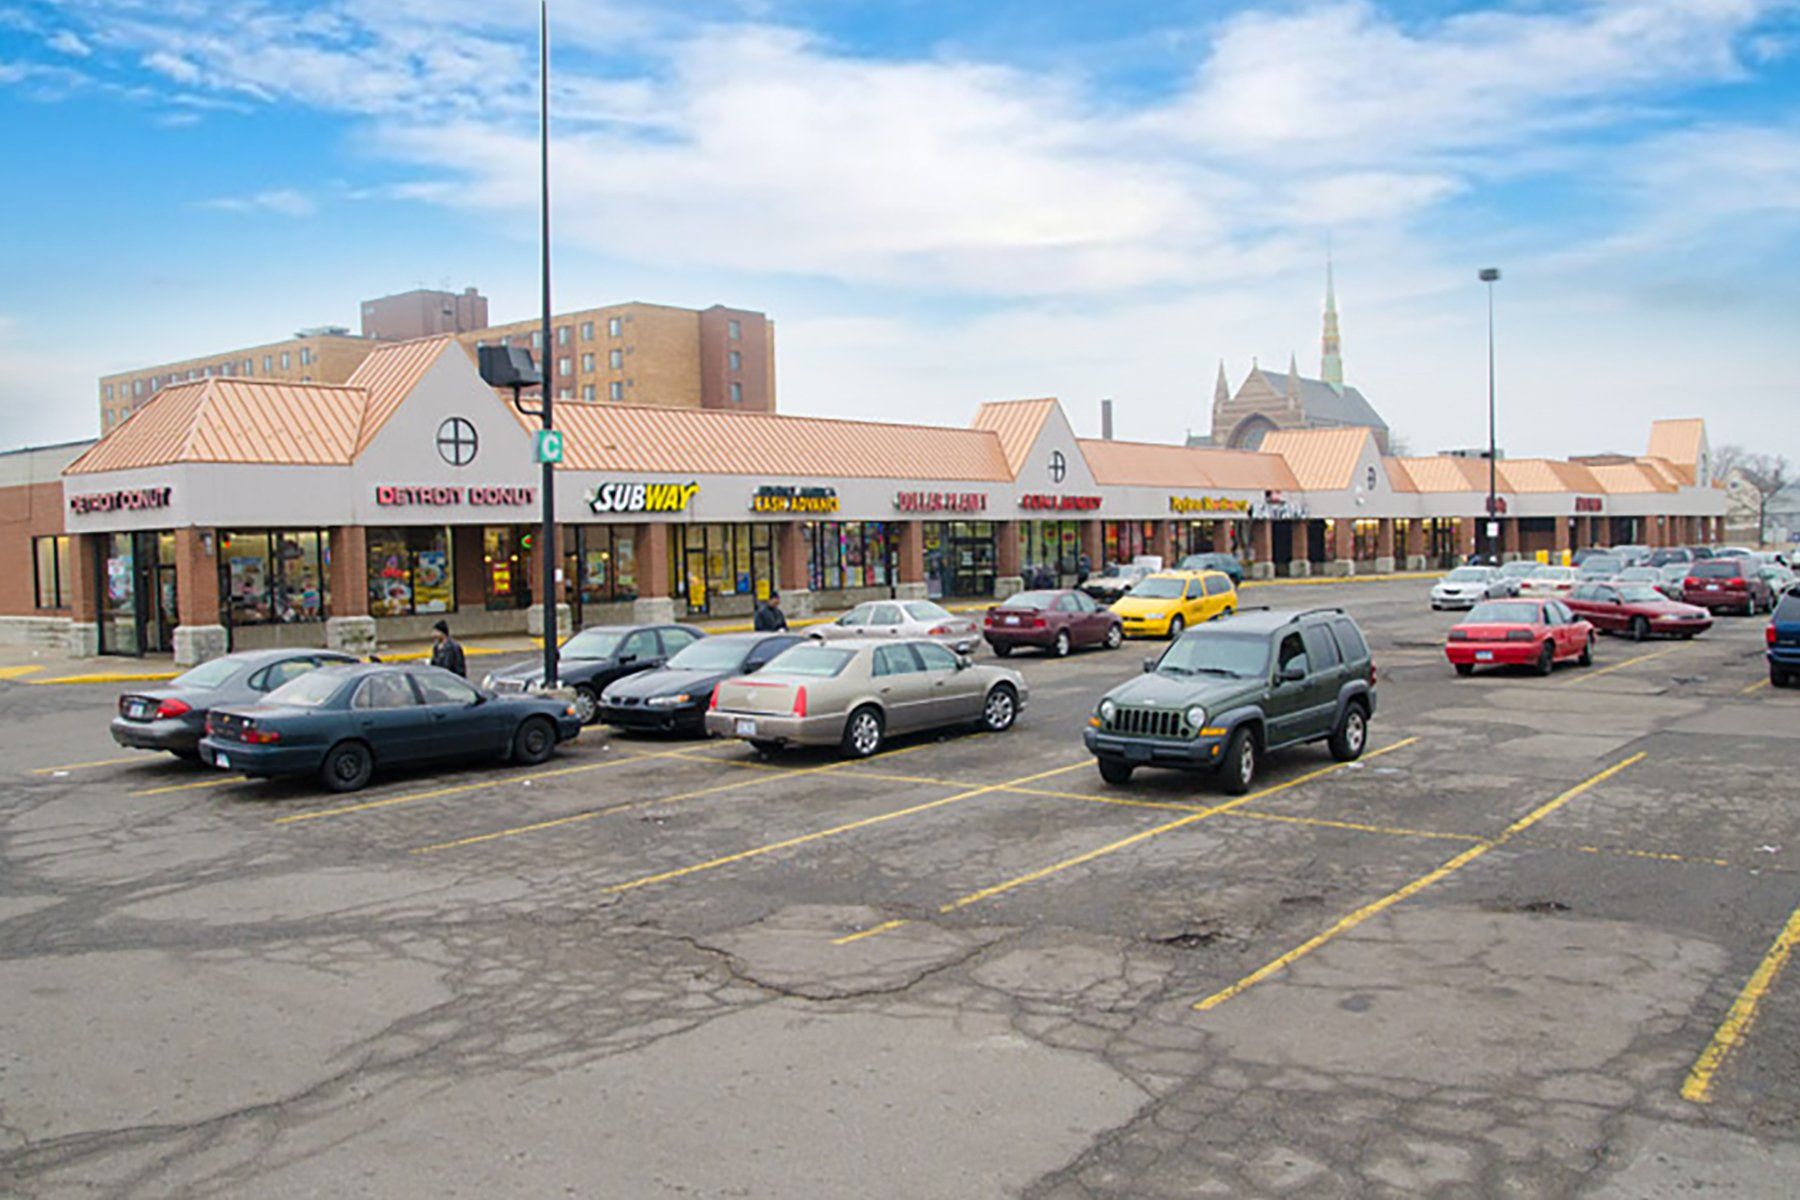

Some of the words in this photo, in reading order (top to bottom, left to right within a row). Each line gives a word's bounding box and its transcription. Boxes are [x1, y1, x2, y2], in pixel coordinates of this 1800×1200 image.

[543, 433, 560, 459] C
[70, 490, 123, 514] DETROIT
[122, 486, 172, 511] DONUT
[376, 486, 464, 506] DETROIT
[468, 487, 536, 506] DONUT
[591, 481, 700, 514] SUBWAY
